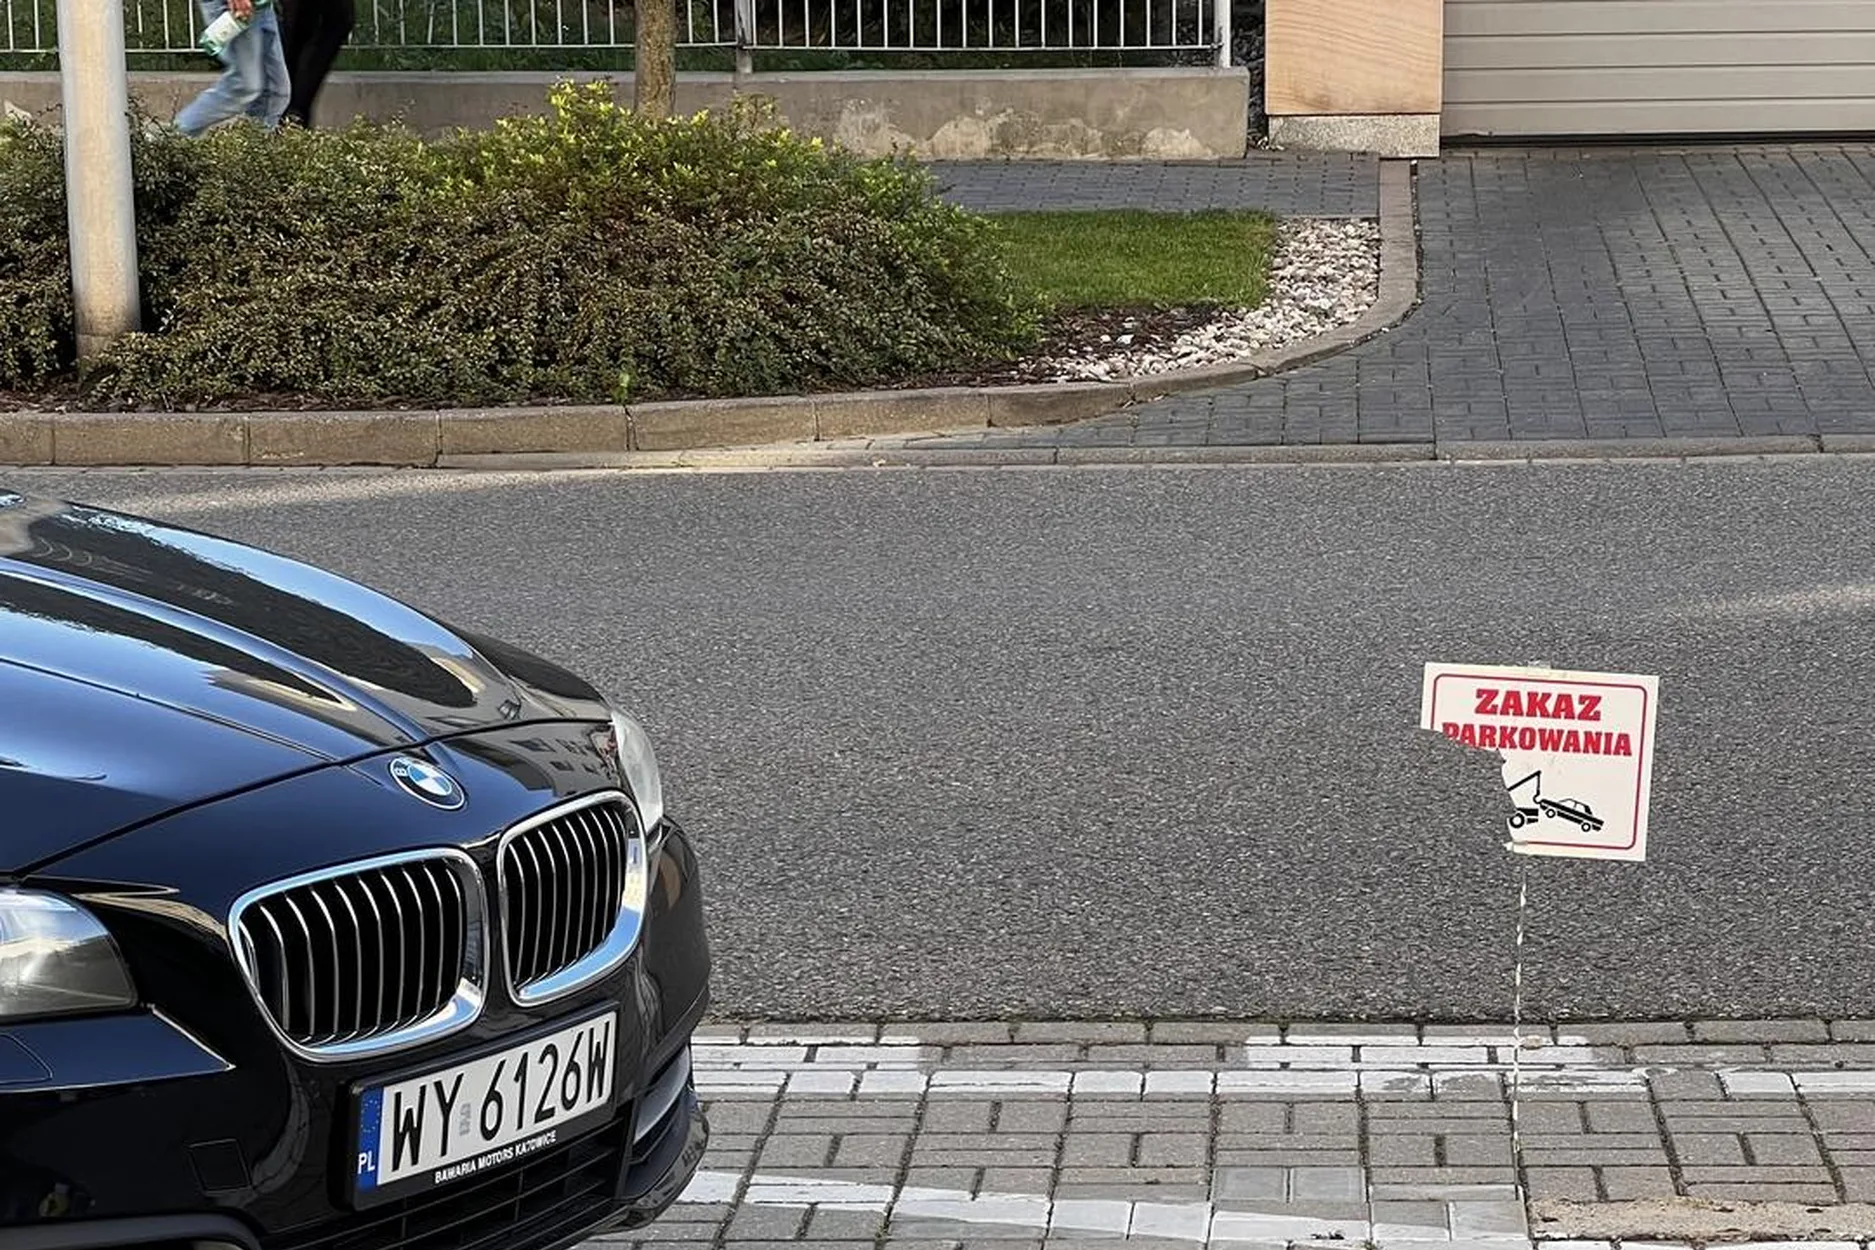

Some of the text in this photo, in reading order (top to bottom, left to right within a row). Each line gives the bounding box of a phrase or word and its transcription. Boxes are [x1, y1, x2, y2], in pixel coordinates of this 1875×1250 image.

[1474, 688, 1602, 721] ZAKAZ
[1442, 722, 1632, 756] PARKOWANIA
[392, 1021, 610, 1172] WY 6126W
[358, 1150, 375, 1174] PL
[478, 1147, 514, 1170] MOTORS
[515, 1130, 557, 1157] KATOWICE
